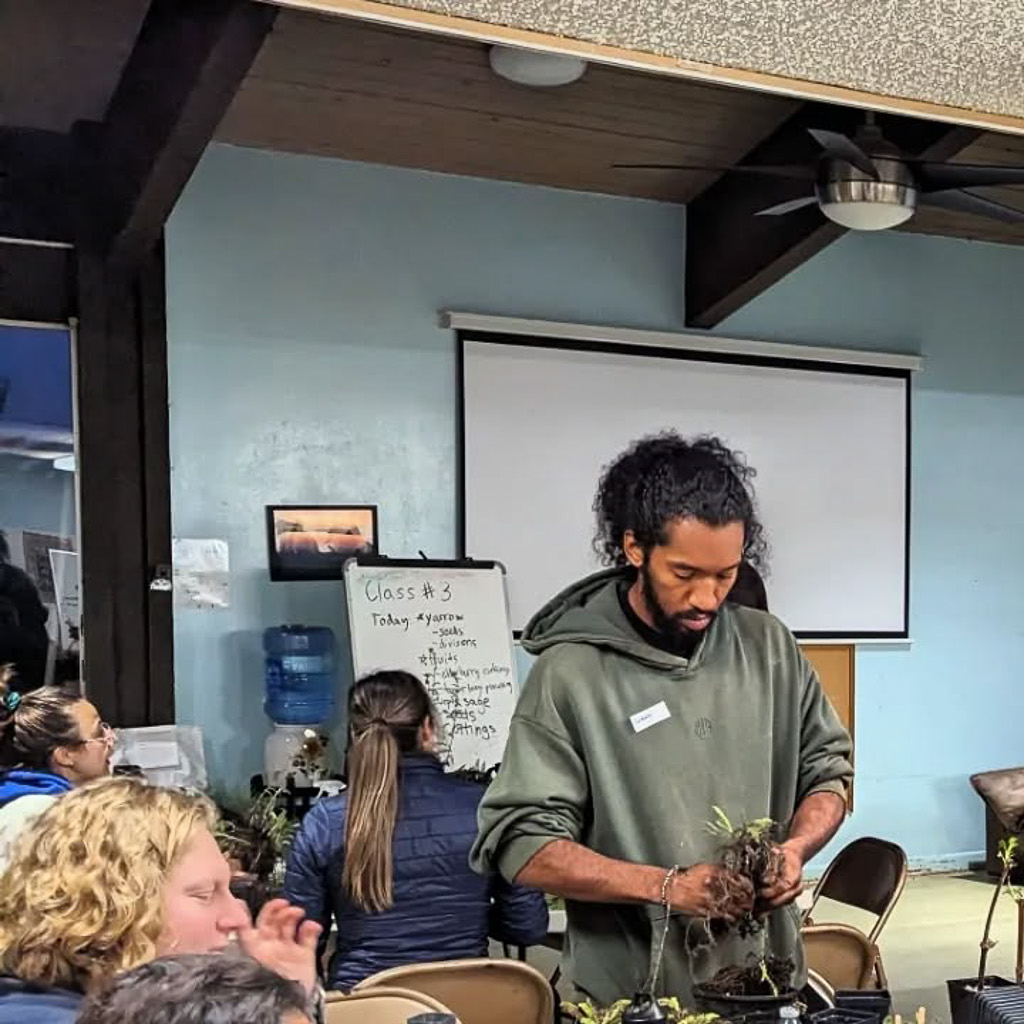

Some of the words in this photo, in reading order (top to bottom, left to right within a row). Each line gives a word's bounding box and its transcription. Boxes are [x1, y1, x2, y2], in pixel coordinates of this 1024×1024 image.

[365, 580, 415, 602] Class
[371, 612, 409, 632] Today
[463, 697, 491, 715] sage
